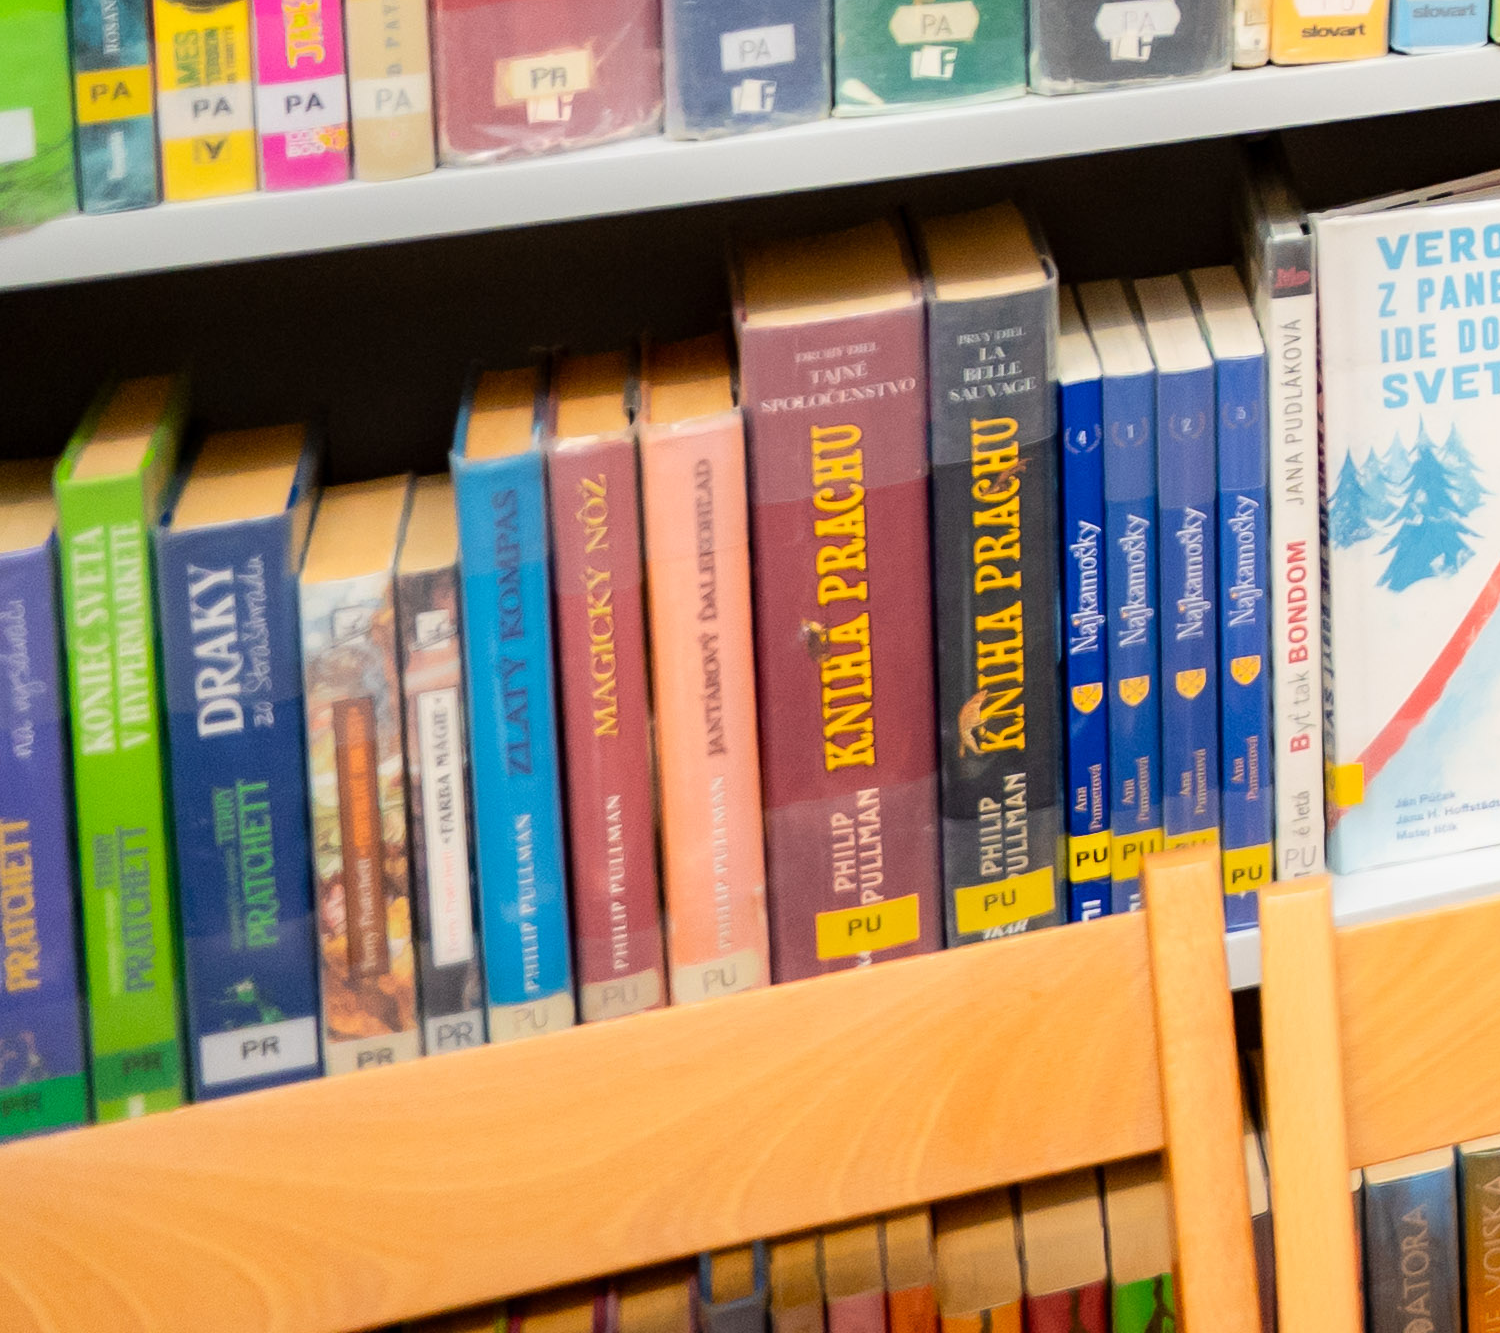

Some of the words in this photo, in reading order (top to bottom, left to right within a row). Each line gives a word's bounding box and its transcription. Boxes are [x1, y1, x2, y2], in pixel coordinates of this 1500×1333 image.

[284, 92, 324, 113] PA
[1377, 284, 1396, 317] Z
[1379, 322, 1439, 362] IDE
[1284, 319, 1303, 445] PUDLÁKOVÁ
[810, 422, 866, 605] PRACHU
[972, 415, 1022, 598] PRACHU
[1284, 454, 1304, 505] JANA
[1069, 518, 1102, 654] Najkamošky
[1175, 506, 1208, 641] Najkamošky
[1228, 495, 1260, 626] Najkamošky
[1288, 540, 1308, 666] BONDOM
[187, 564, 246, 737] DRAKY
[823, 615, 876, 771] KNIHA
[976, 598, 1027, 754] KNIHA
[833, 811, 854, 894] PHILIP
[859, 786, 881, 903] PULLMAN
[1075, 847, 1108, 868] PU
